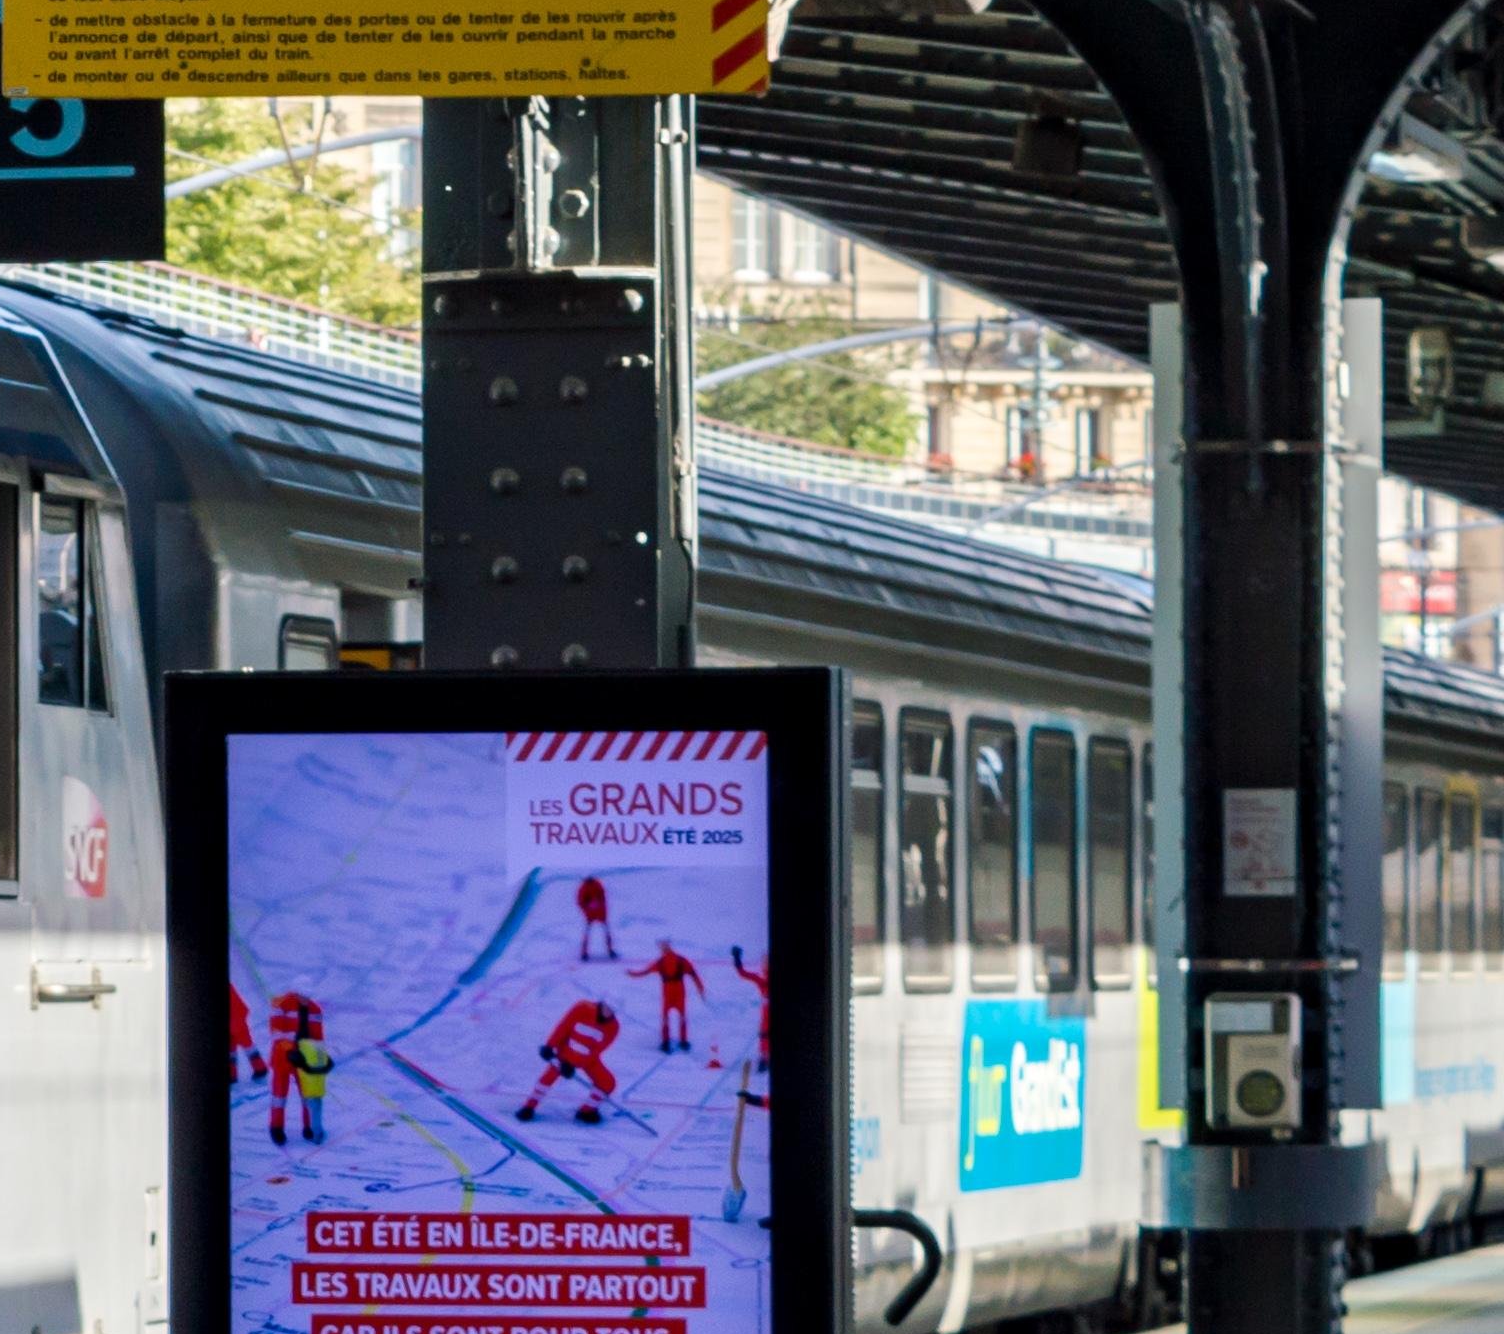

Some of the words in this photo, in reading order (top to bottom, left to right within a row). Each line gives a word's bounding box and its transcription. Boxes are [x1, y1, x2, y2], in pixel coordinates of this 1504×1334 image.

[49, 14, 68, 27] de
[75, 14, 125, 26] mettre
[132, 13, 200, 26] obstacle
[206, 14, 216, 27] à
[222, 14, 235, 27] la
[242, 13, 317, 26] fermeture
[324, 13, 352, 26] des
[359, 14, 409, 28] portes
[416, 15, 435, 25] ou
[442, 13, 461, 25] de
[469, 13, 514, 25] tenter
[521, 11, 541, 24] de
[547, 11, 570, 23] les
[576, 11, 626, 24] rouvrir
[633, 10, 677, 25] après
[136, 30, 157, 43] de
[232, 30, 270, 43] ainsi
[277, 33, 308, 45] que
[316, 31, 336, 43] de
[344, 27, 394, 44] tenter
[402, 30, 422, 42] de
[430, 29, 454, 43] les
[462, 30, 508, 42] ouvrir
[516, 28, 584, 43] pendant
[592, 28, 606, 41] la
[614, 28, 676, 41] marche
[48, 51, 68, 61] ou
[75, 49, 116, 61] avant
[177, 48, 240, 62] complet
[248, 48, 268, 60] du
[275, 48, 313, 60] train.
[48, 70, 67, 83] de
[73, 70, 128, 82] monter
[135, 72, 154, 82] ou
[161, 69, 180, 84] de
[188, 68, 270, 83] descendre
[277, 69, 331, 83] ailleurs
[338, 72, 367, 84] que
[374, 69, 411, 82] dans
[418, 69, 441, 82] les
[529, 799, 563, 817] LES
[569, 782, 744, 816] GRANDS
[529, 821, 659, 845] TRAVAUX
[662, 826, 696, 845] ÉTÉ
[702, 829, 744, 844] 2025
[314, 1220, 366, 1248] CET
[372, 1215, 420, 1248] ÉTÉ
[427, 1221, 464, 1248] EN
[470, 1215, 683, 1253] ÎLE-DE-FRANCE,
[299, 1271, 349, 1298] LES
[354, 1272, 482, 1299] TRAVAUX
[487, 1273, 562, 1300] SONT
[568, 1274, 696, 1302] PARTOUT
